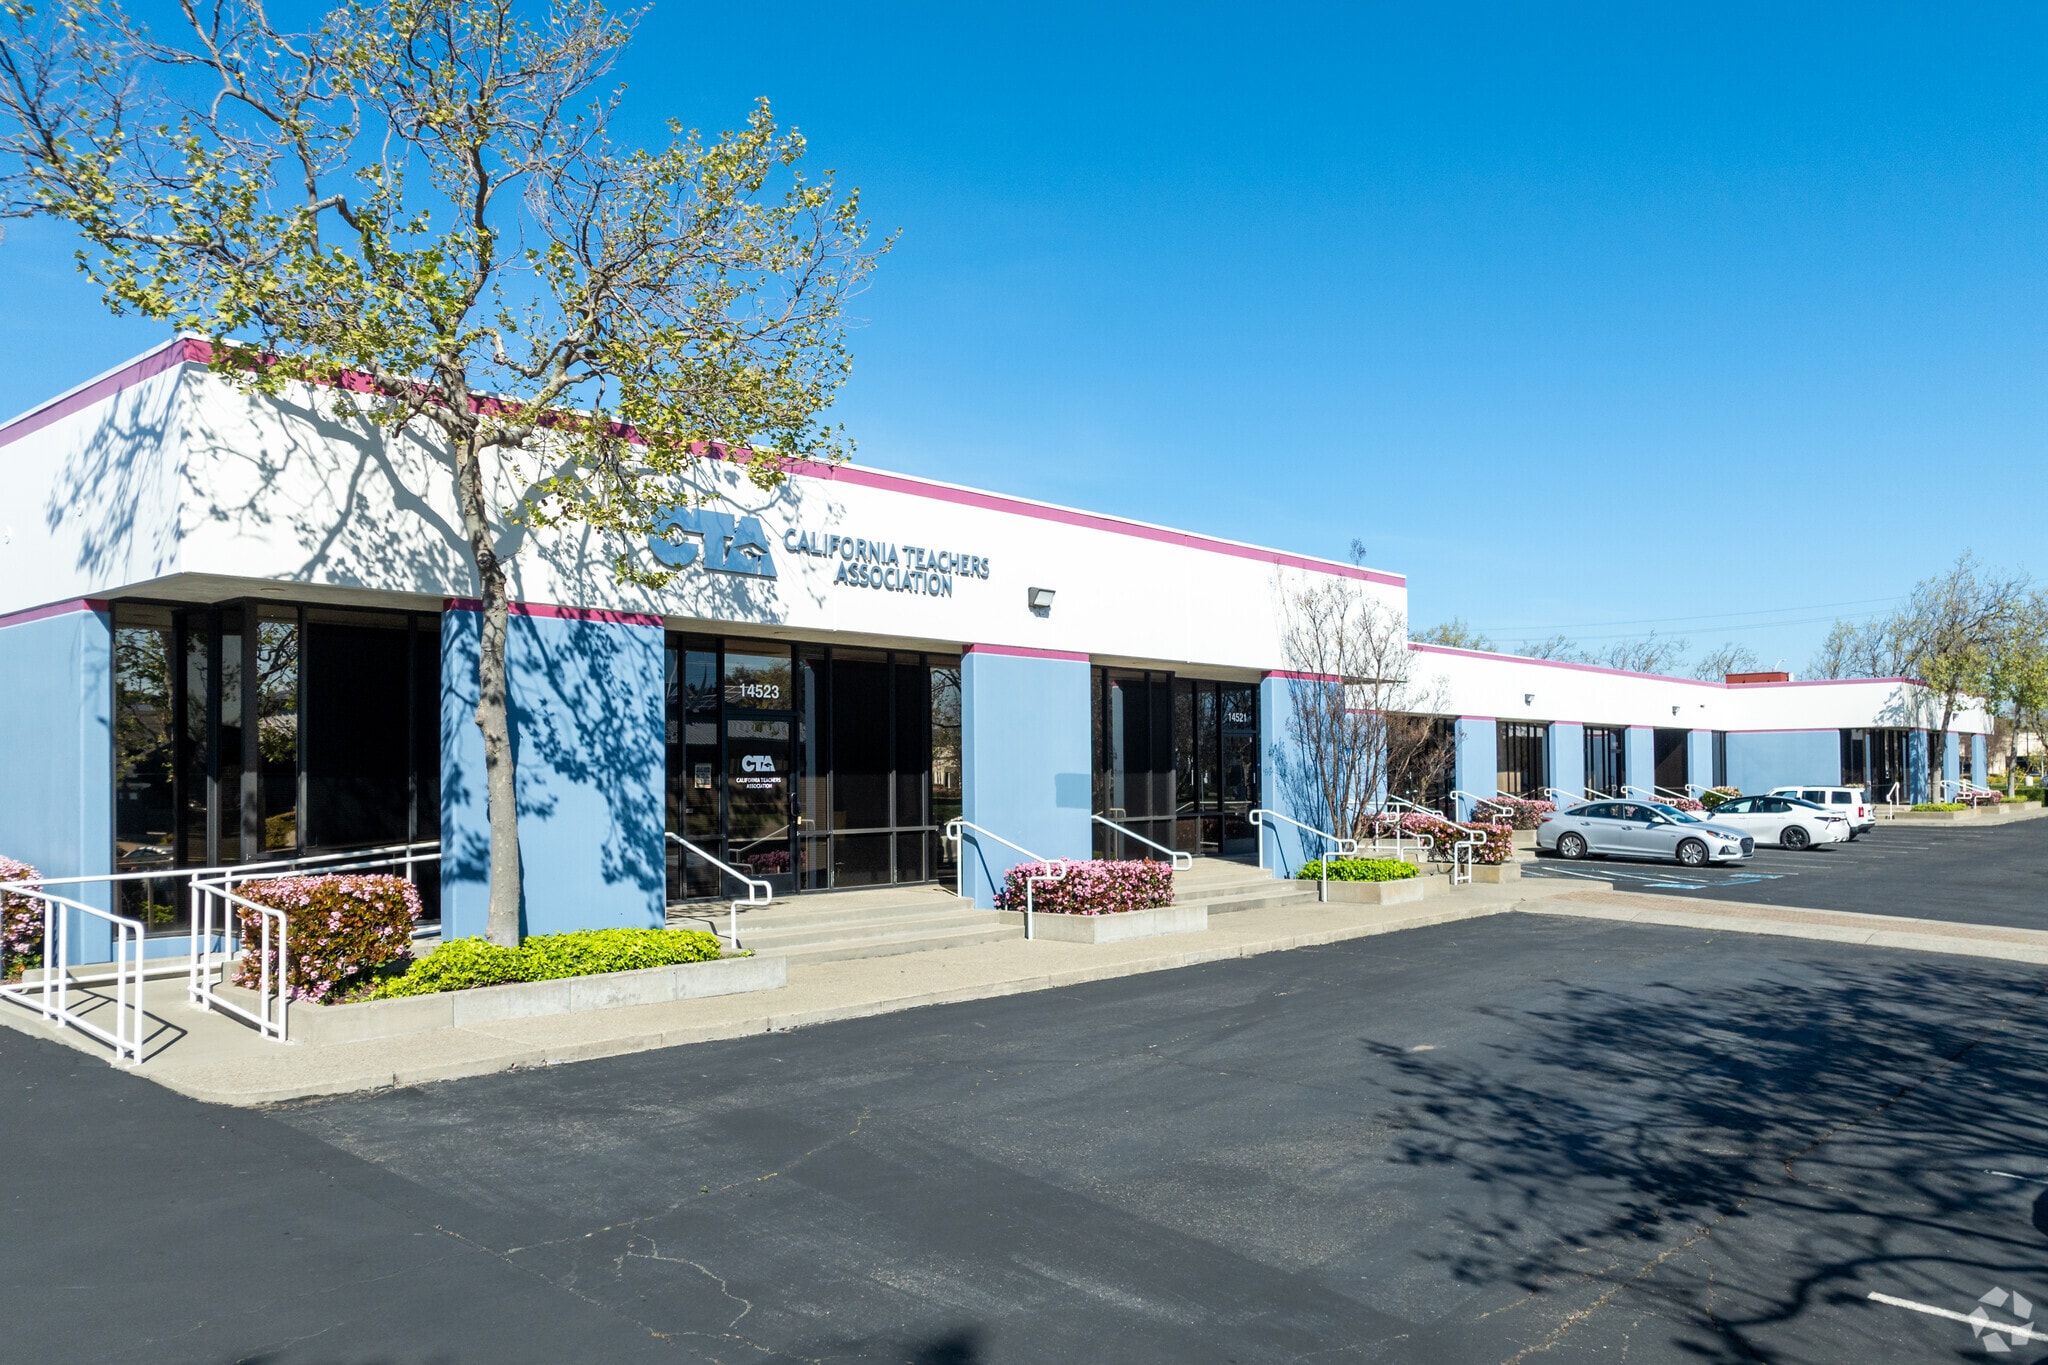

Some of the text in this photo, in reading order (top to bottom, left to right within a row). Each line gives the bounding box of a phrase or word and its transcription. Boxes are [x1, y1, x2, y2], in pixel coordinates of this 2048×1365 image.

[647, 504, 778, 581] CTA
[783, 528, 990, 580] CALIFORNIA TEACHERS
[834, 561, 953, 598] ASSOCIATION
[739, 683, 780, 699] 14523
[1228, 712, 1247, 723] 14521
[741, 754, 776, 772] CTA
